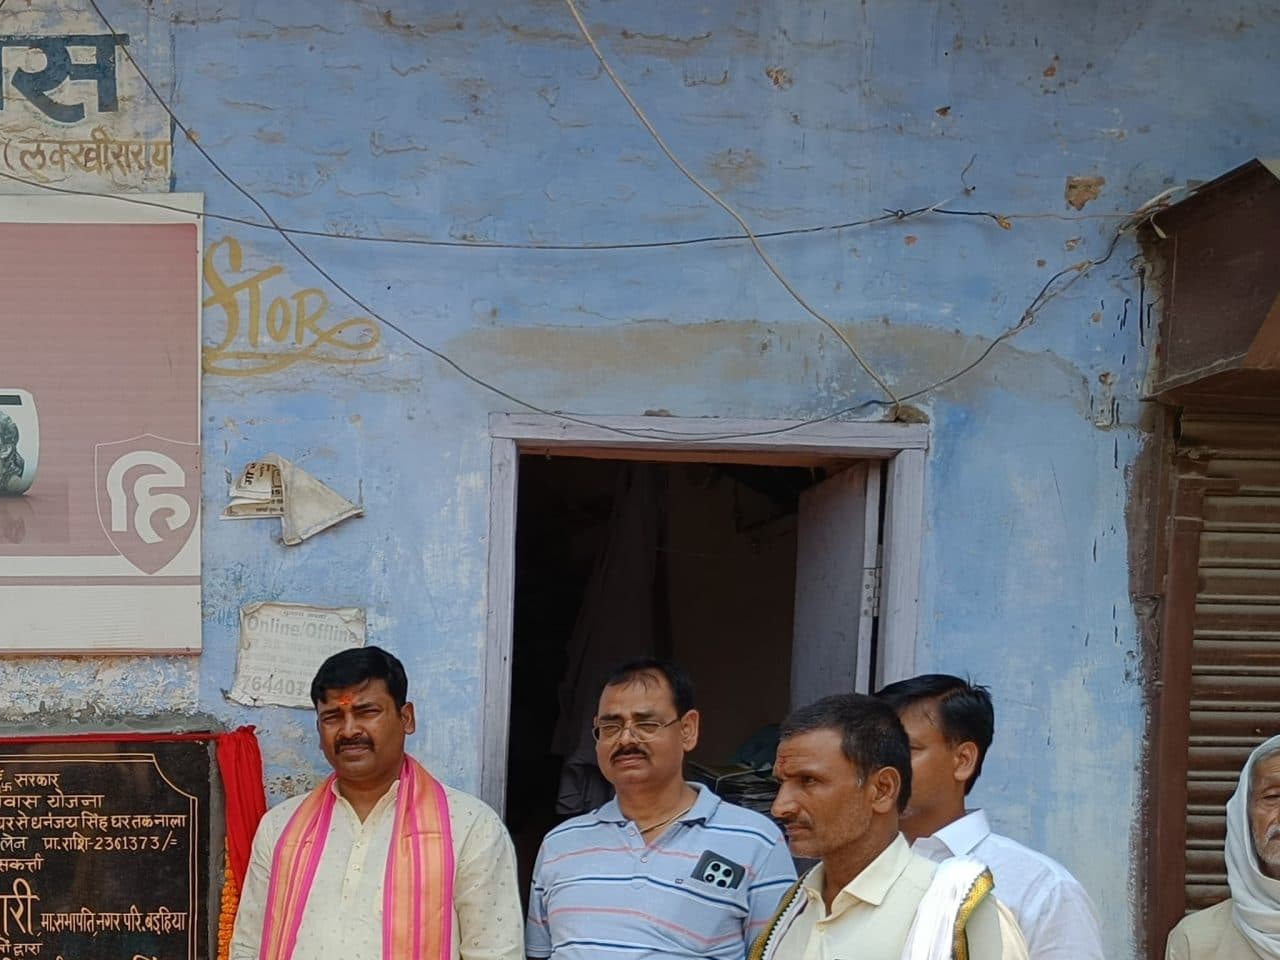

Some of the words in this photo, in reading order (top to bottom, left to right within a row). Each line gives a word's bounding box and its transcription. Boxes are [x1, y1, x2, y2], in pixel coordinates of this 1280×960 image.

[15, 773, 60, 788] सरकार
[47, 788, 105, 809] योजना
[17, 810, 32, 829] से
[32, 812, 79, 830] धनंजय
[81, 810, 108, 832] सिंह
[111, 814, 132, 829] घर
[133, 814, 154, 829] तक
[155, 814, 187, 829] नाला
[0, 833, 28, 852] लेन
[97, 912, 121, 931] नगर
[13, 943, 44, 957] द्वारा
